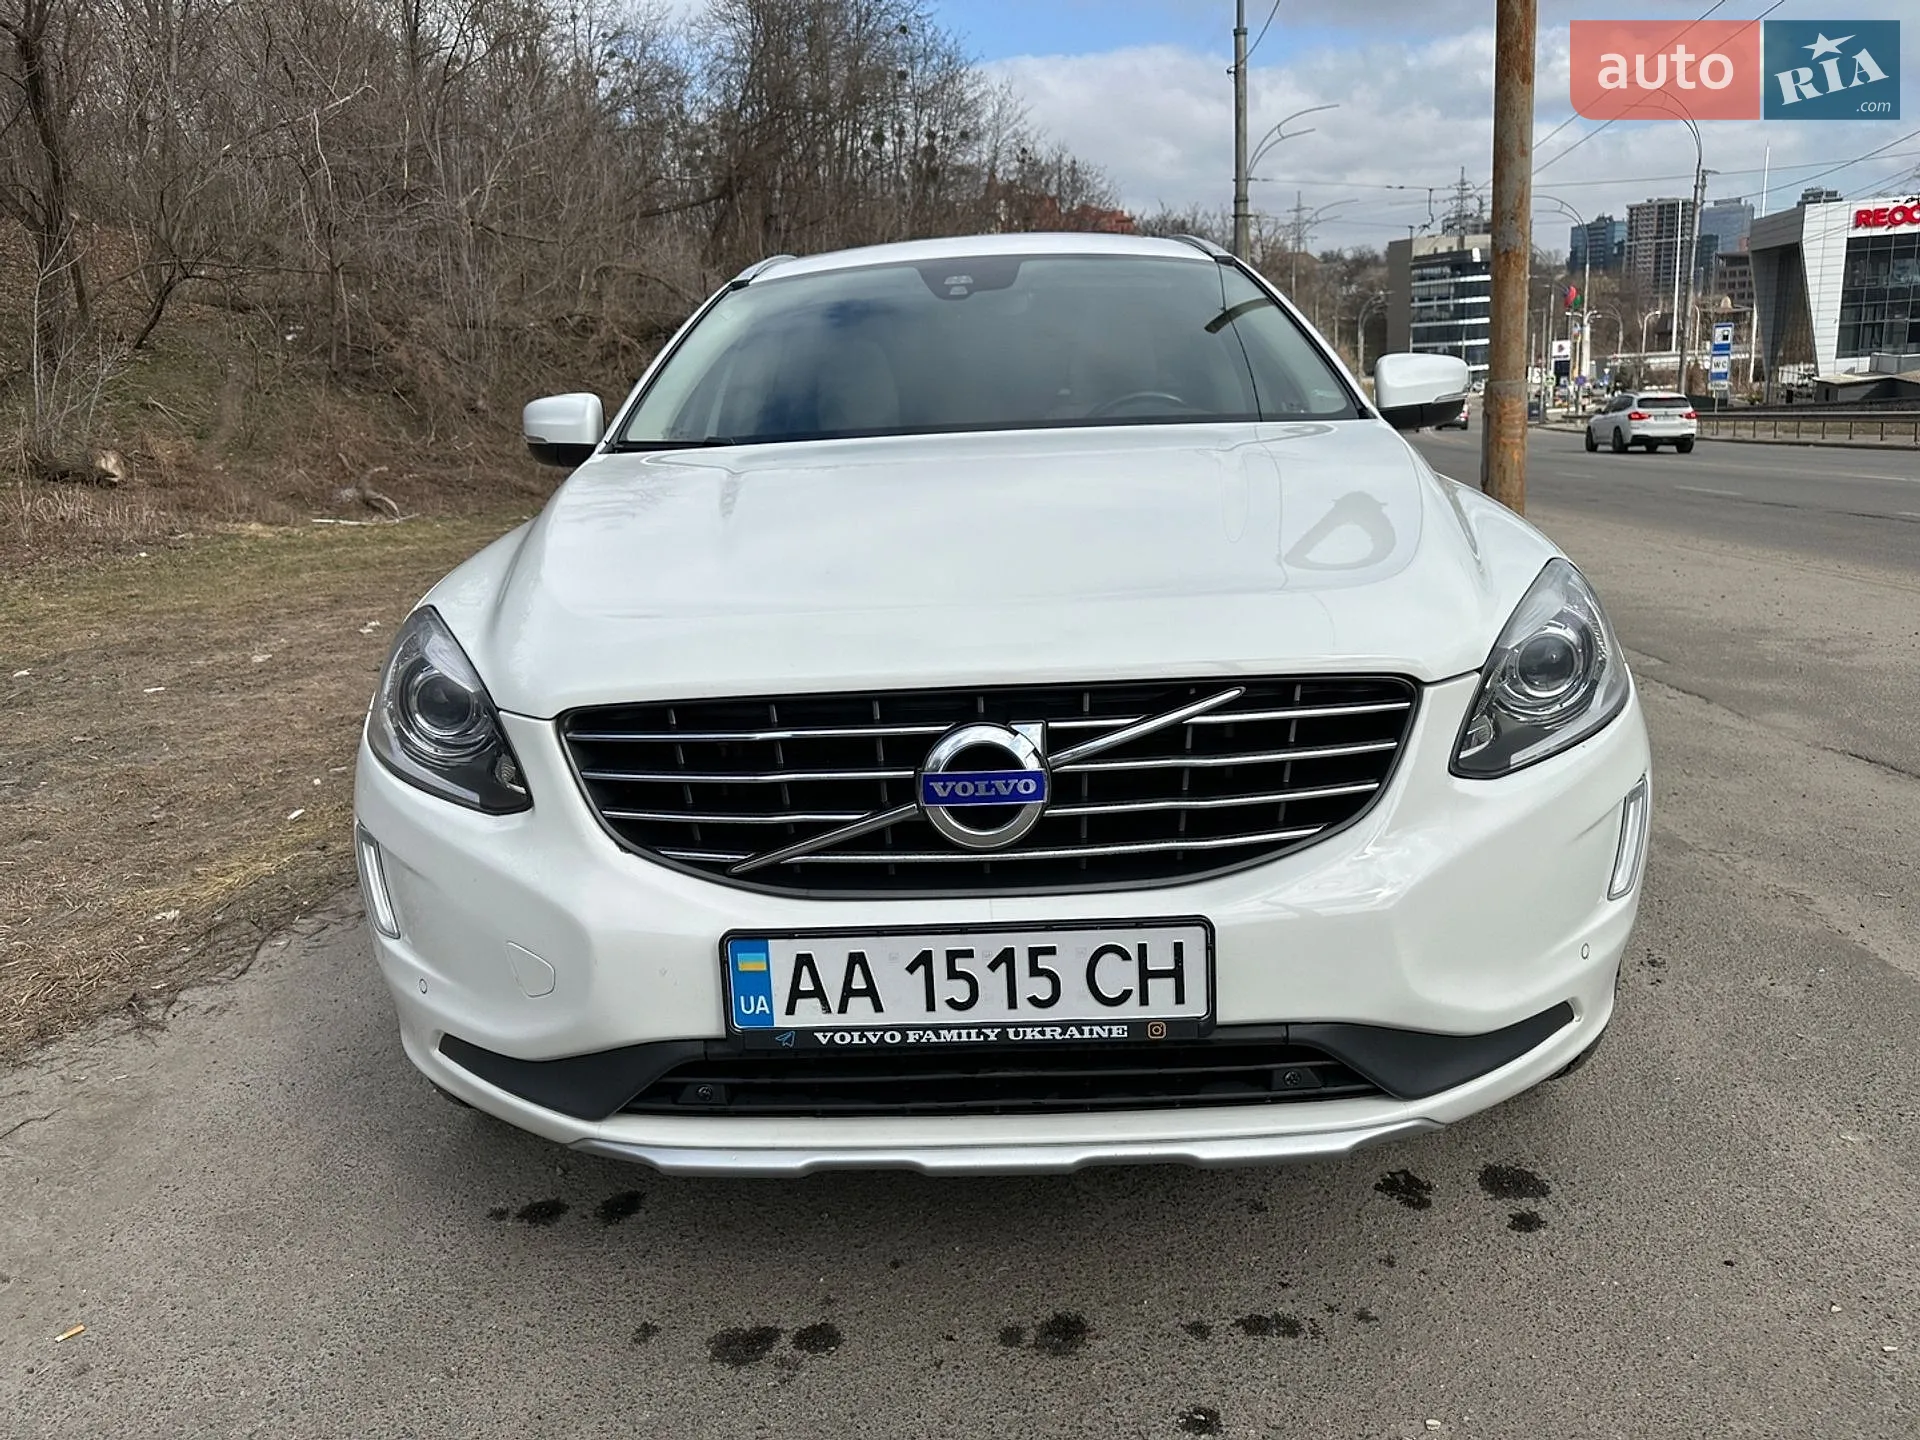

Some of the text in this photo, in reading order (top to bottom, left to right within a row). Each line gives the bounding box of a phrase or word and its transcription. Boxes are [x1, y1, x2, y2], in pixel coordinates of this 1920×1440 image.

[929, 778, 1037, 798] VOLVO
[785, 941, 1185, 1016] AA 1515 CH
[740, 995, 770, 1015] UA
[814, 1024, 1128, 1046] VOLVO FAMILY UKRAINE
